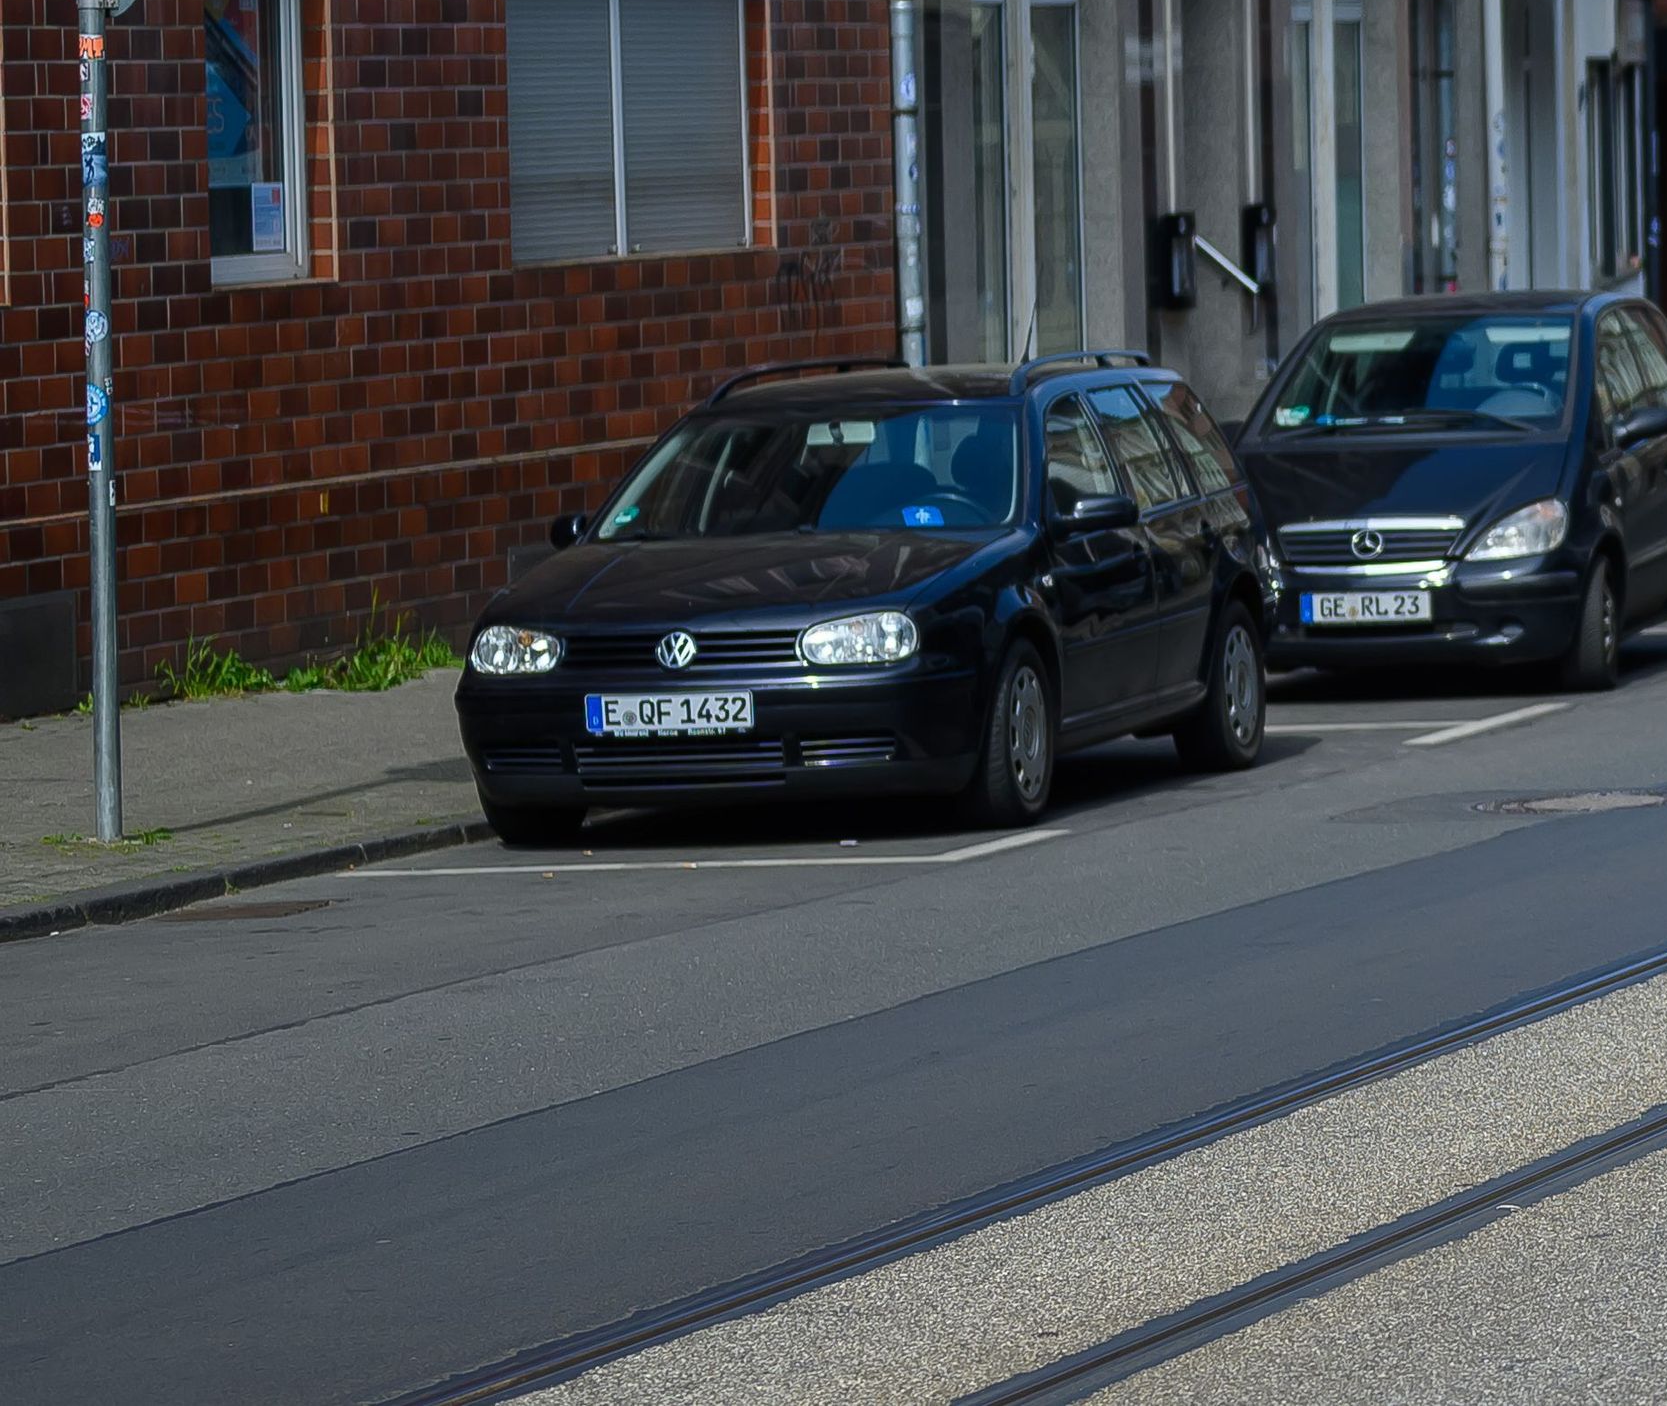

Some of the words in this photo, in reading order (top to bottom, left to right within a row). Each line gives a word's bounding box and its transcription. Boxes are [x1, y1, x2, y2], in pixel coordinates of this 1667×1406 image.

[1320, 596, 1345, 618] GE
[1361, 596, 1388, 616] RL
[1394, 595, 1419, 615] 23
[604, 700, 621, 726] E
[638, 699, 672, 725] QF
[680, 696, 748, 724] 1432
